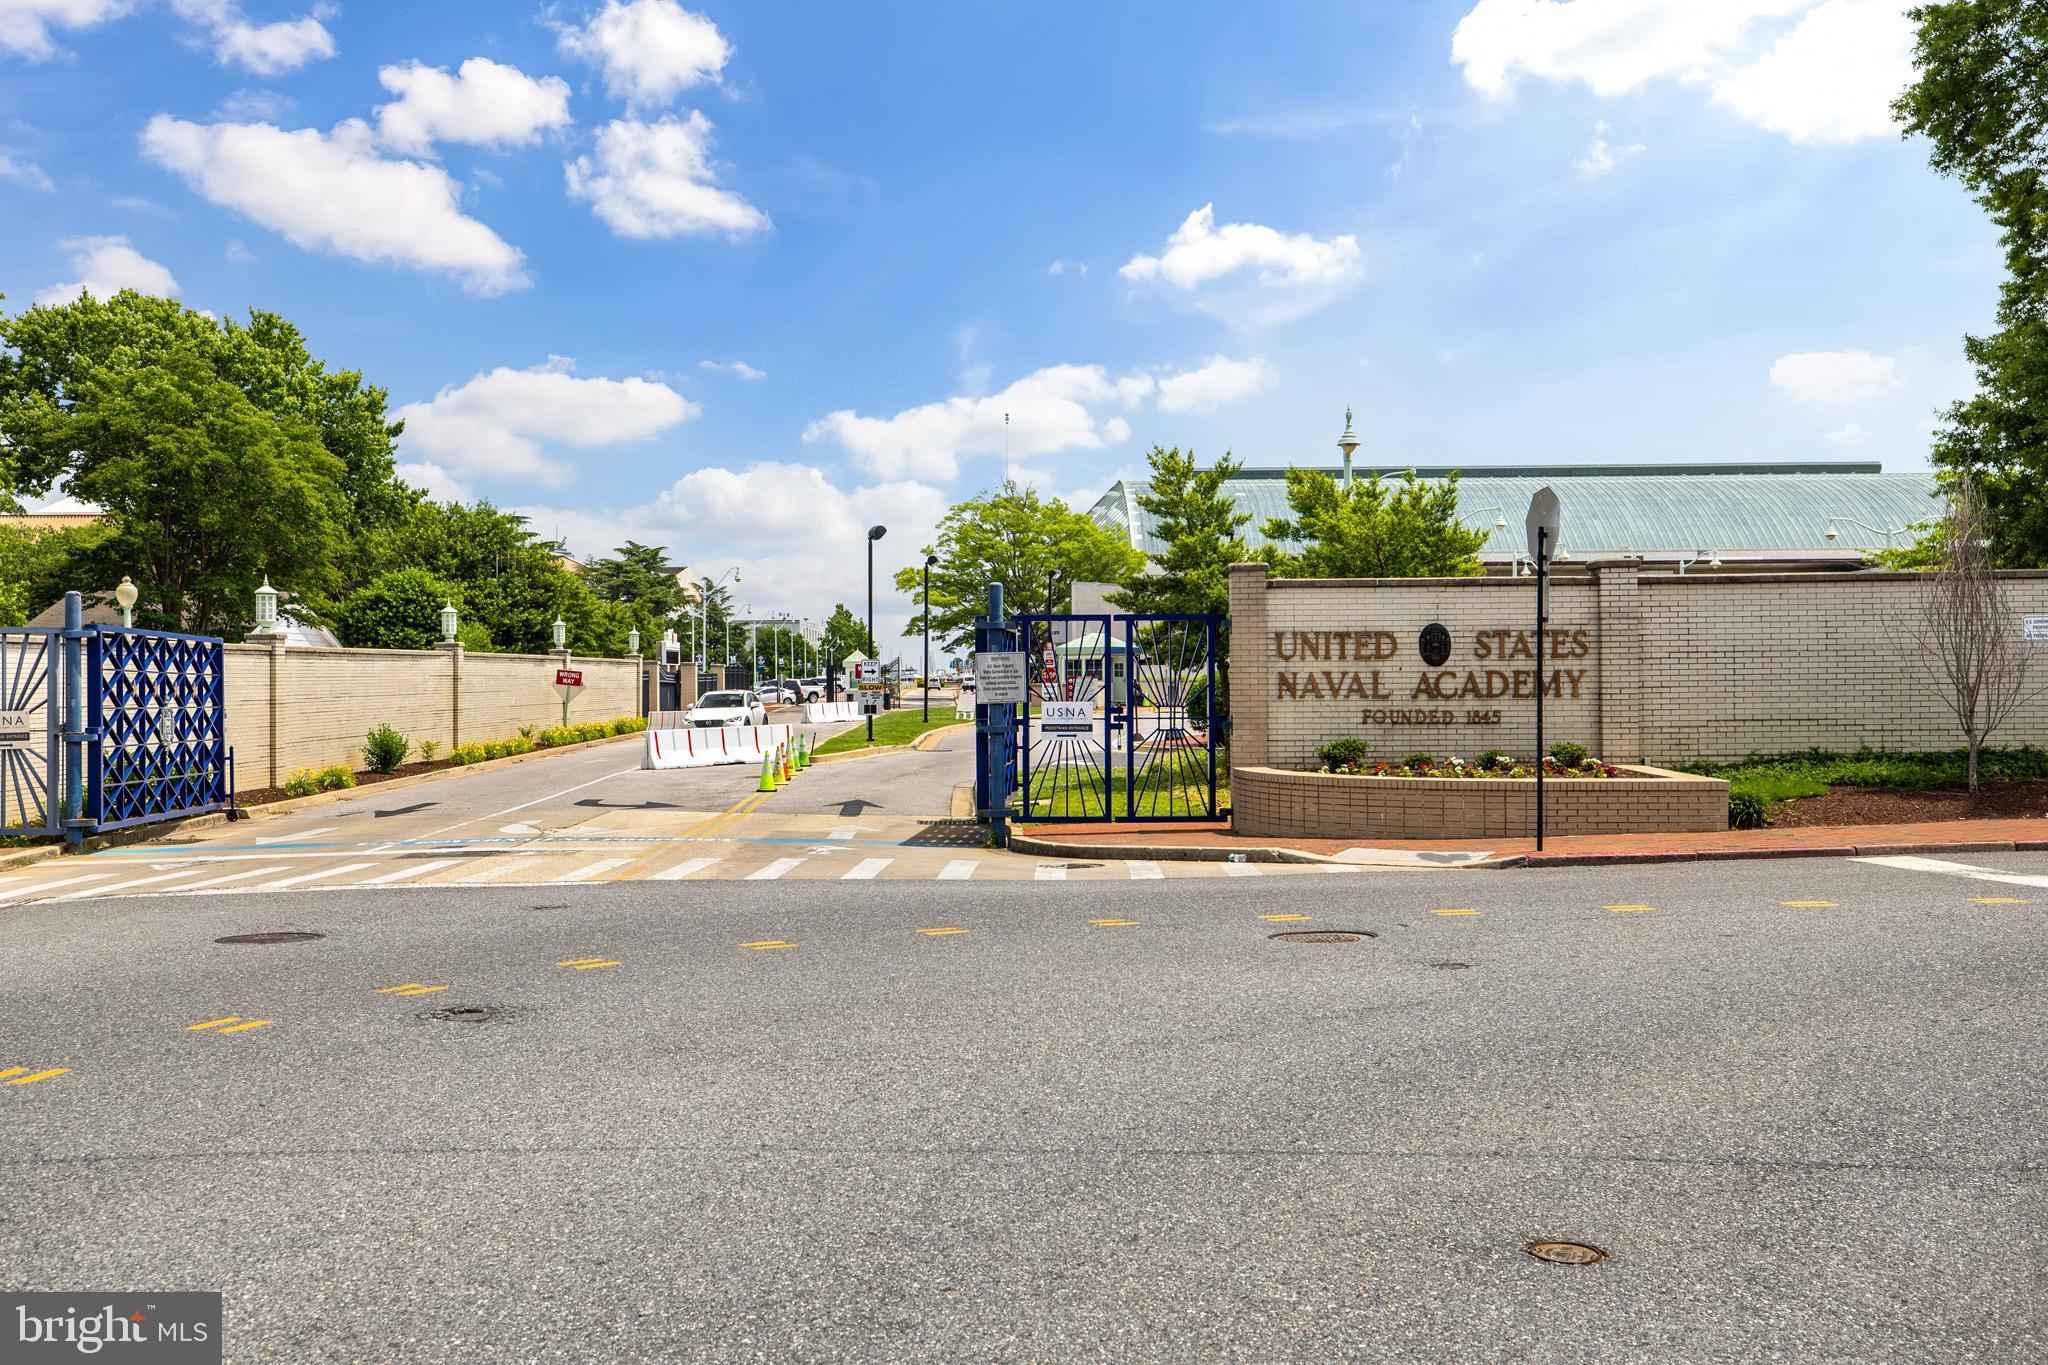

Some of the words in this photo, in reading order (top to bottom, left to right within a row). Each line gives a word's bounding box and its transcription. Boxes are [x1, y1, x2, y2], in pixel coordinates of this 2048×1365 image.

[1275, 631, 1398, 661] UNITED
[1278, 671, 1391, 699] NAVAL
[1411, 669, 1587, 699] ACADEMY
[1046, 707, 1086, 718] USNA
[1362, 709, 1454, 724] FOUNDED
[1466, 710, 1502, 724] 1845
